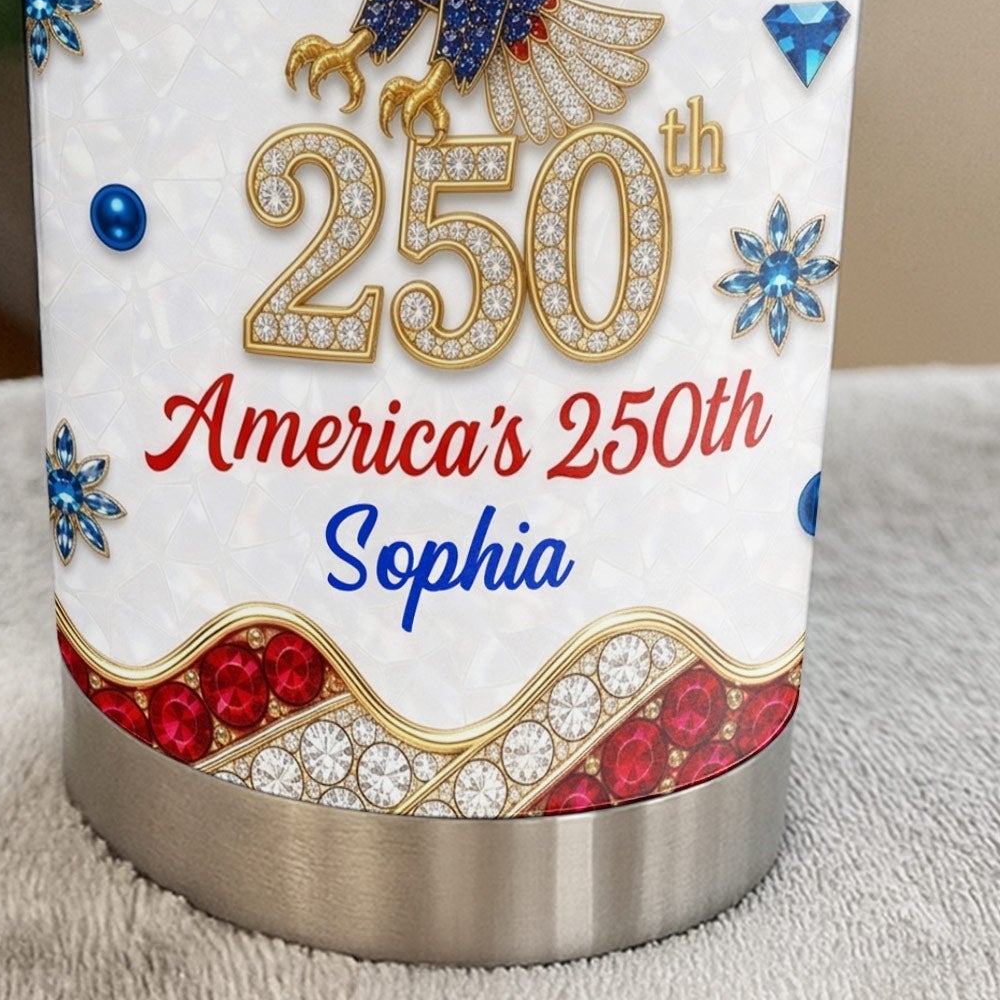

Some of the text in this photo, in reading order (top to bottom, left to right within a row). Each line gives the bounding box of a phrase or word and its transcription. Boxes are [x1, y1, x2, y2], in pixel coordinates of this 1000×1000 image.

[243, 95, 727, 369] 250th
[144, 369, 773, 480] America's 250th
[324, 503, 575, 632] Sophia
